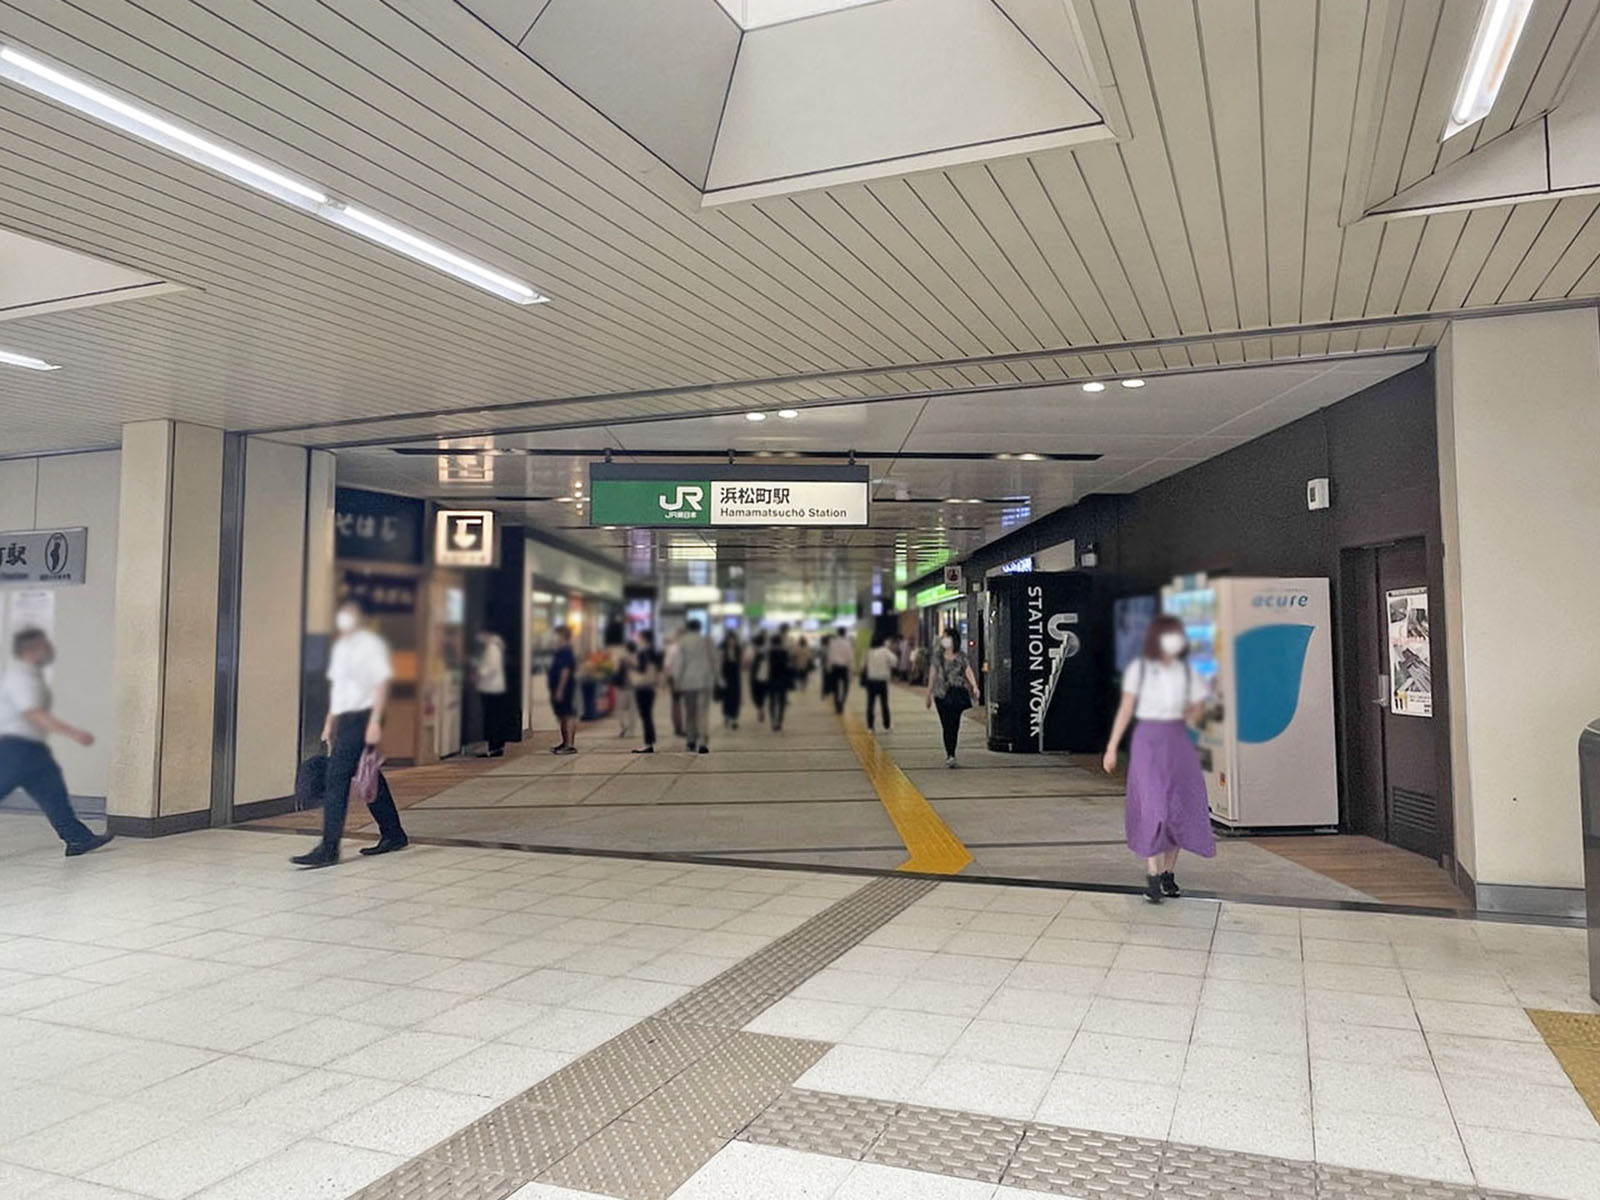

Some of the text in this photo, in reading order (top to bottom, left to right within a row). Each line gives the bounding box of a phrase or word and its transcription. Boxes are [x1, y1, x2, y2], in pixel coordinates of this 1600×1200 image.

[659, 486, 704, 511] JR
[720, 487, 790, 504] 浜松町駅
[808, 508, 847, 518] Station
[1252, 594, 1309, 608] acure
[1028, 586, 1045, 737] STATION WORK
